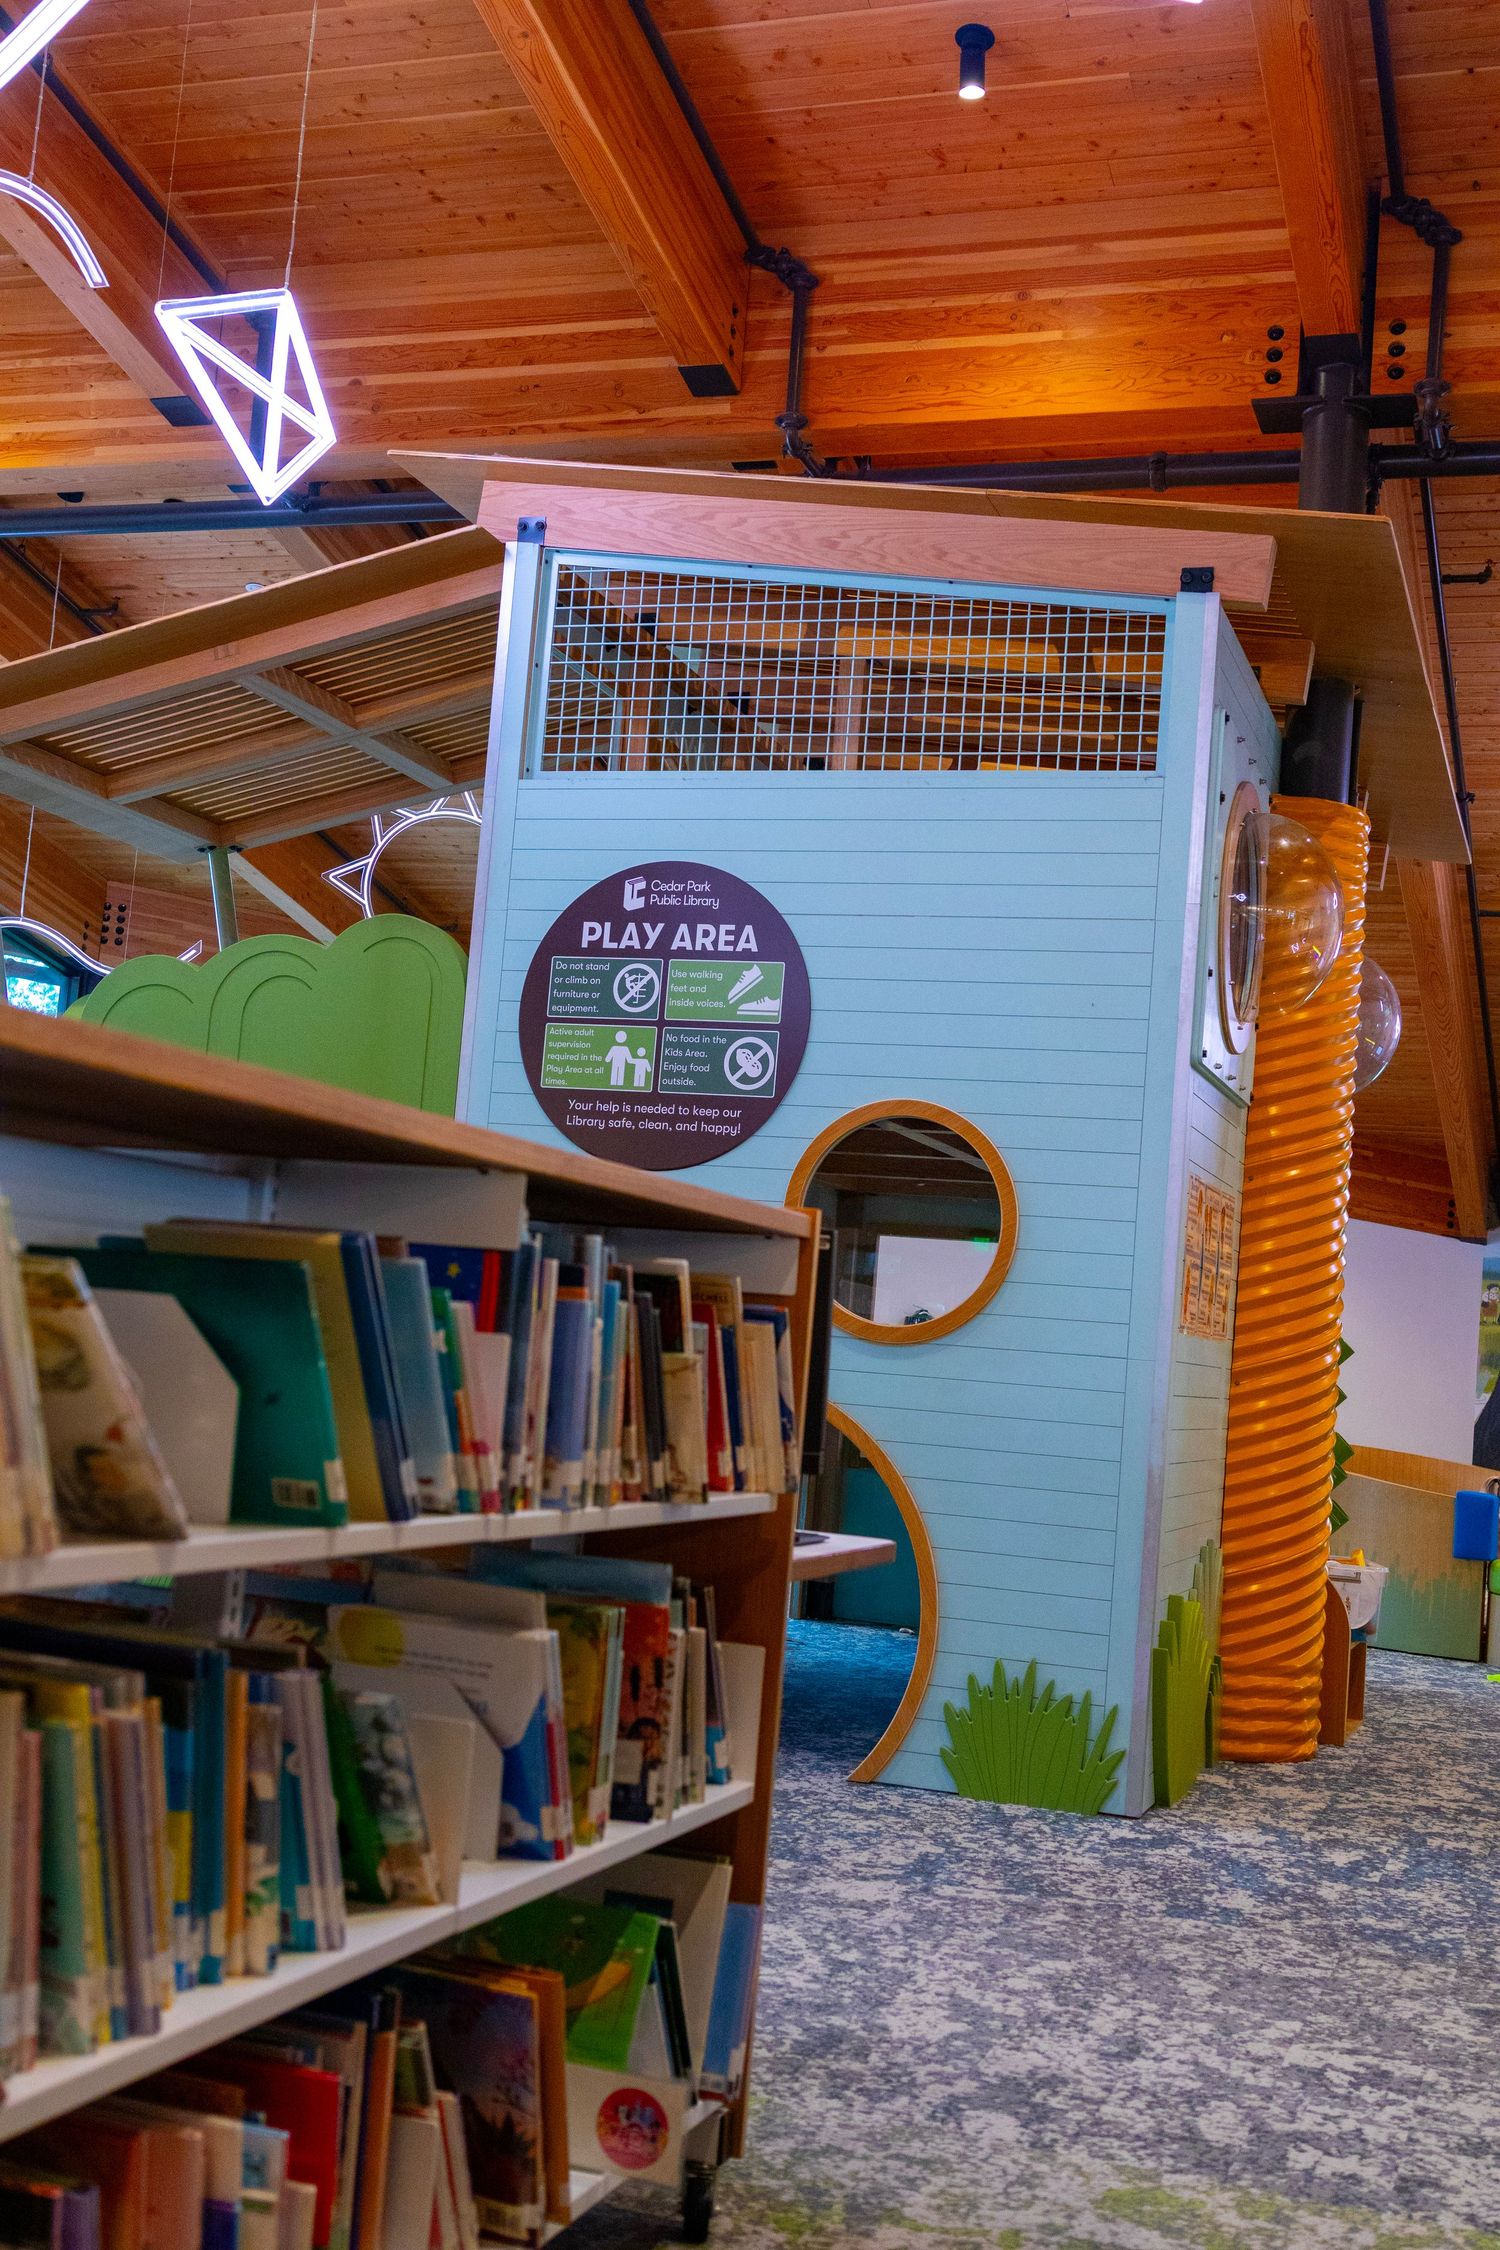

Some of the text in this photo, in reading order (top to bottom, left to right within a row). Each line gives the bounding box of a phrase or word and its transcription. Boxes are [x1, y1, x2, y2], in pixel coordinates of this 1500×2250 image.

[650, 879, 711, 892] Cedar Park
[649, 894, 720, 910] Public Library
[581, 921, 759, 952] PLAY AREA
[555, 961, 610, 971] Do not stand
[564, 976, 588, 984] climb
[671, 970, 723, 981] Use walking
[670, 984, 707, 993] feet and
[553, 989, 601, 999] furniture or
[669, 998, 726, 1008] inside voices.
[551, 1004, 599, 1013] equipment.
[549, 1027, 594, 1036] Active adult
[665, 1033, 727, 1044] No food in the
[548, 1040, 591, 1049] supervision
[547, 1053, 602, 1061] required in the
[664, 1048, 708, 1058] Kids Area.
[546, 1064, 604, 1074] Play Area at all
[663, 1062, 710, 1073] Enjoy food
[545, 1077, 568, 1085] times.
[662, 1077, 697, 1086] outside.
[568, 1099, 742, 1119] Your help is needed to keep our
[566, 1115, 741, 1136] Library safe, clean, and happy!
